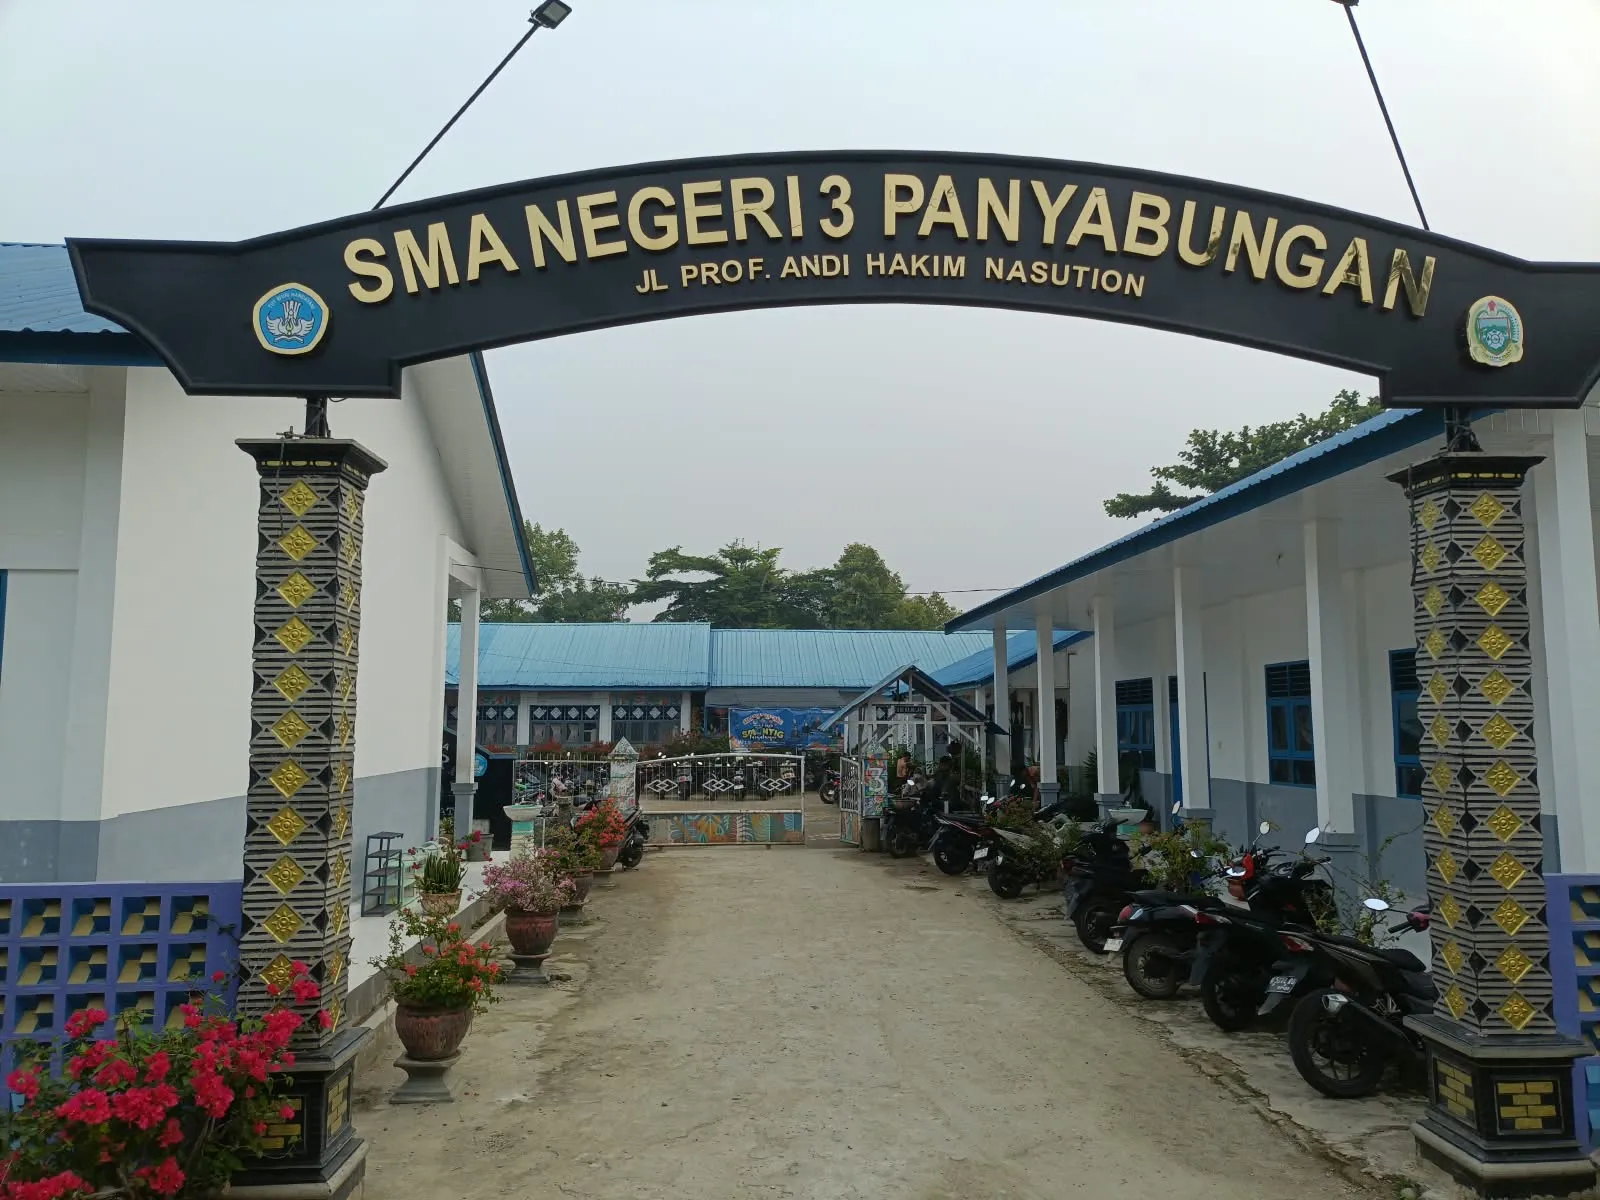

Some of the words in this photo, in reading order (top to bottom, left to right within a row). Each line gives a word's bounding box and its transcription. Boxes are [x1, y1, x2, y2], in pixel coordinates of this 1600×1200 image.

[343, 213, 519, 304] SMA
[525, 175, 804, 268] NEGERI
[819, 174, 855, 239] 3
[884, 173, 1437, 318] PANYABUNGAN
[636, 268, 668, 294] JL
[680, 257, 773, 287] PROF.
[781, 254, 849, 279] ANDI
[866, 253, 969, 278] HAKIM
[985, 257, 1145, 298] NASUTION
